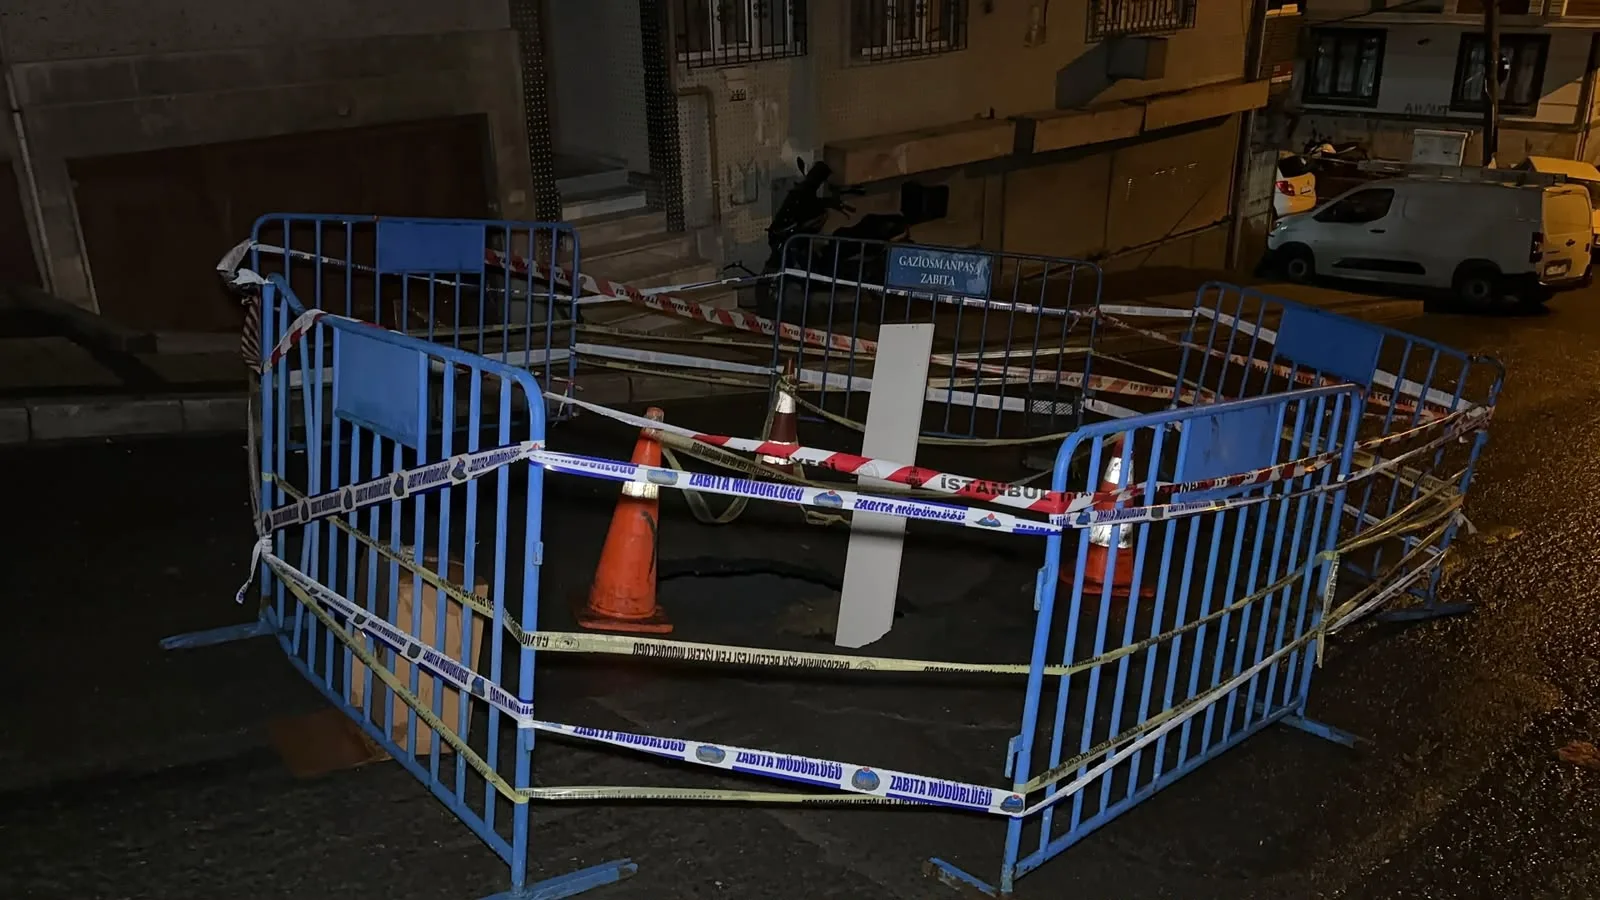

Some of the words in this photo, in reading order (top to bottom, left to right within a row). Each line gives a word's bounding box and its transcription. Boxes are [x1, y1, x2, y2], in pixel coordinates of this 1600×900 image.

[920, 272, 955, 287] ZABITA
[688, 472, 730, 491] ZABITA
[940, 474, 1051, 502] İSTANBUL
[735, 751, 774, 769] ZABITA
[775, 755, 843, 780] MÜDÜRLÜĞÜ
[889, 775, 926, 795] ZABITA
[927, 778, 993, 806] MÜDÜRLÜĞÜ
